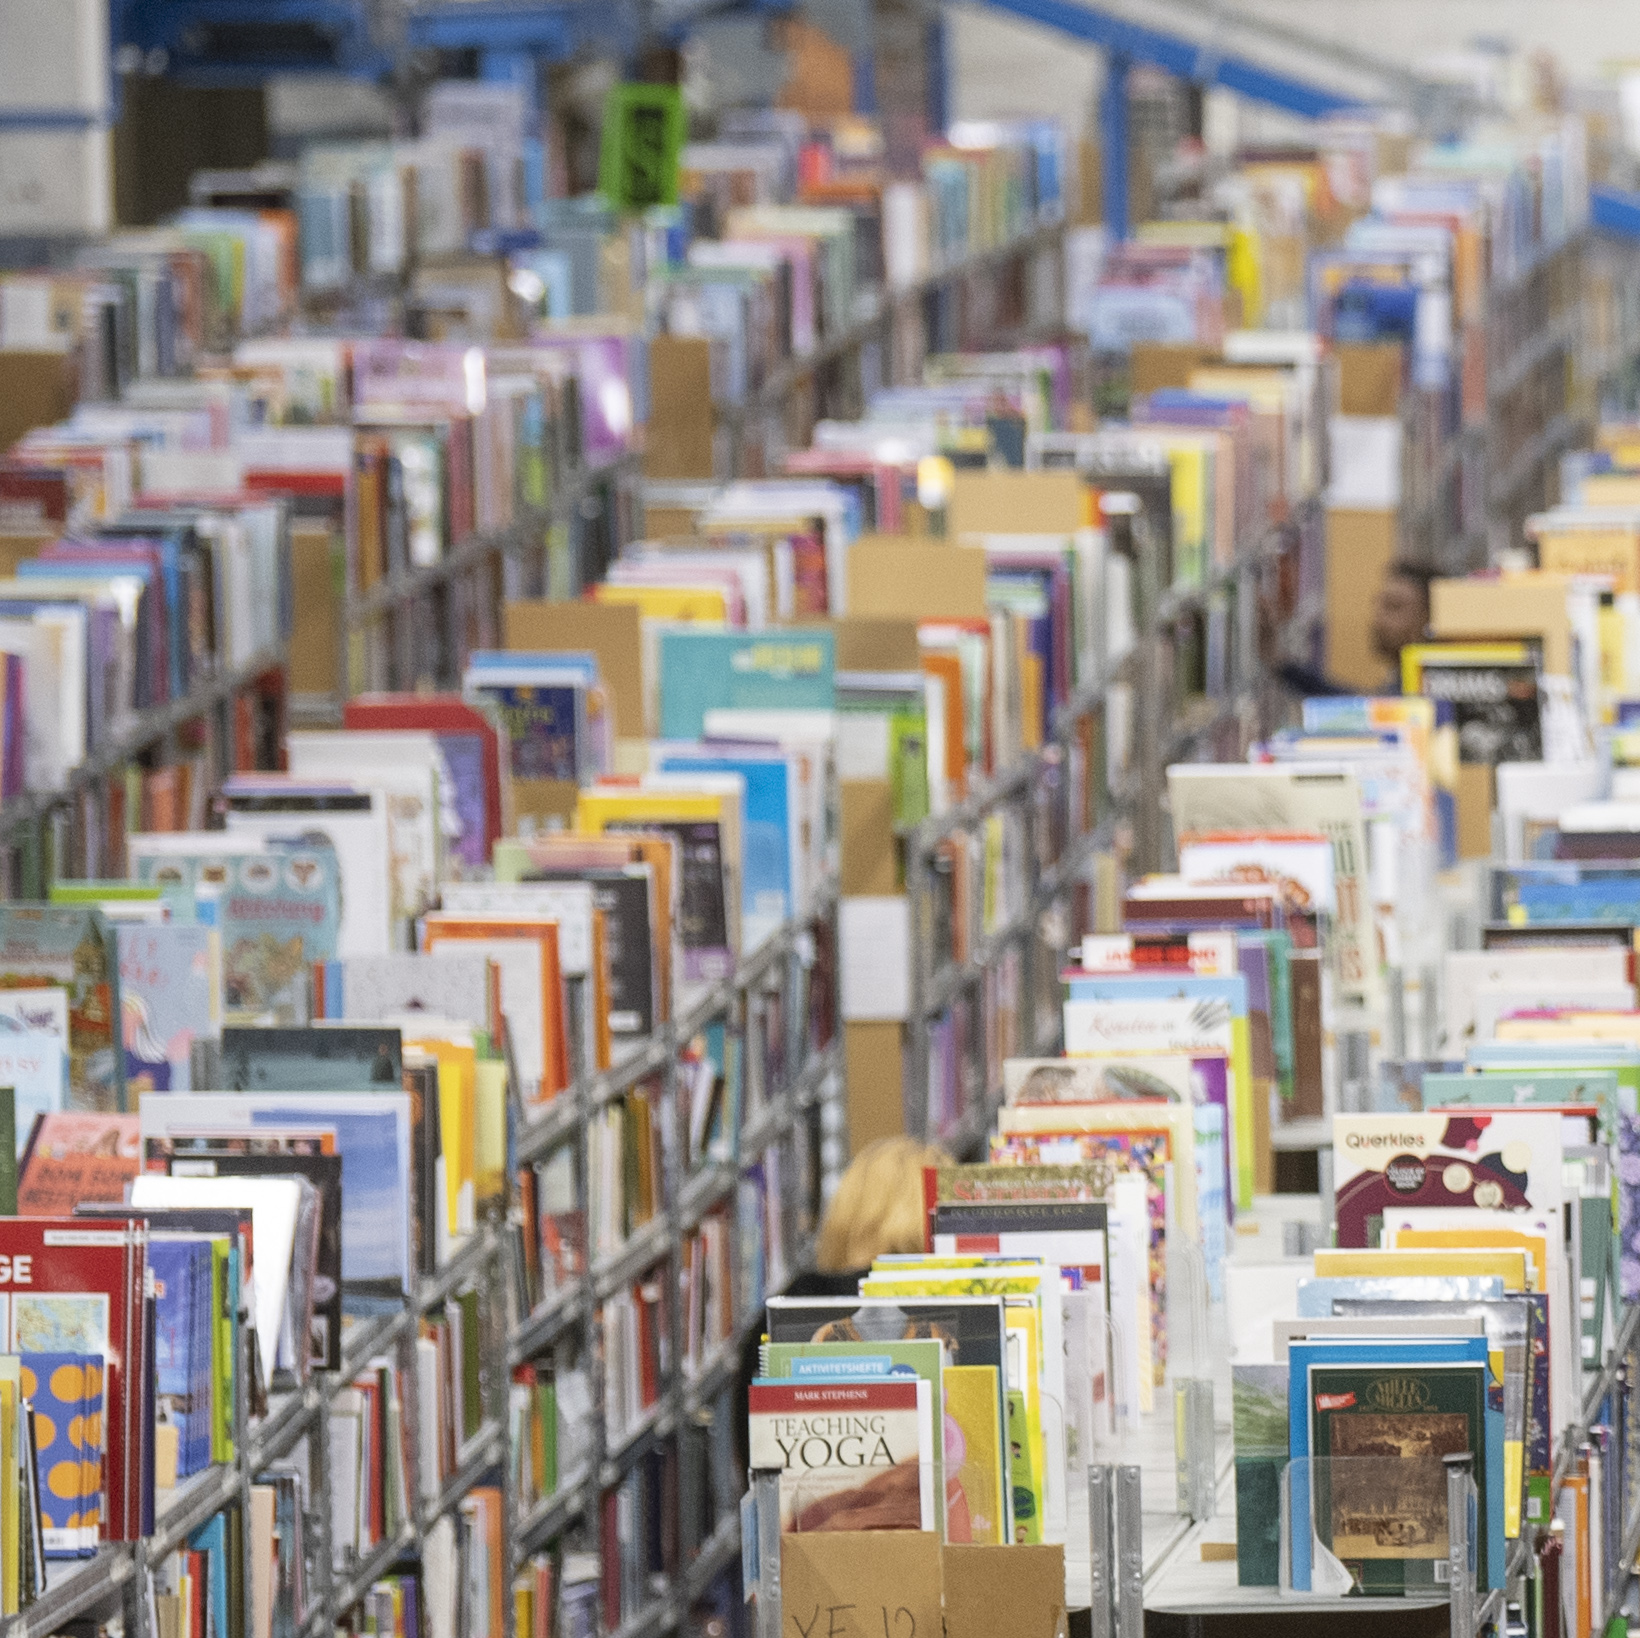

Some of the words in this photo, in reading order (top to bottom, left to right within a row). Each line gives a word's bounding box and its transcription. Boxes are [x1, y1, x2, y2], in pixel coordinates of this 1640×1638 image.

[798, 1361, 884, 1375] AKTIVITETSHEFTE
[794, 1391, 819, 1401] MARK
[821, 1389, 869, 1400] STEPHENS
[770, 1415, 886, 1438] TEACHING
[775, 1435, 897, 1469] YOGA
